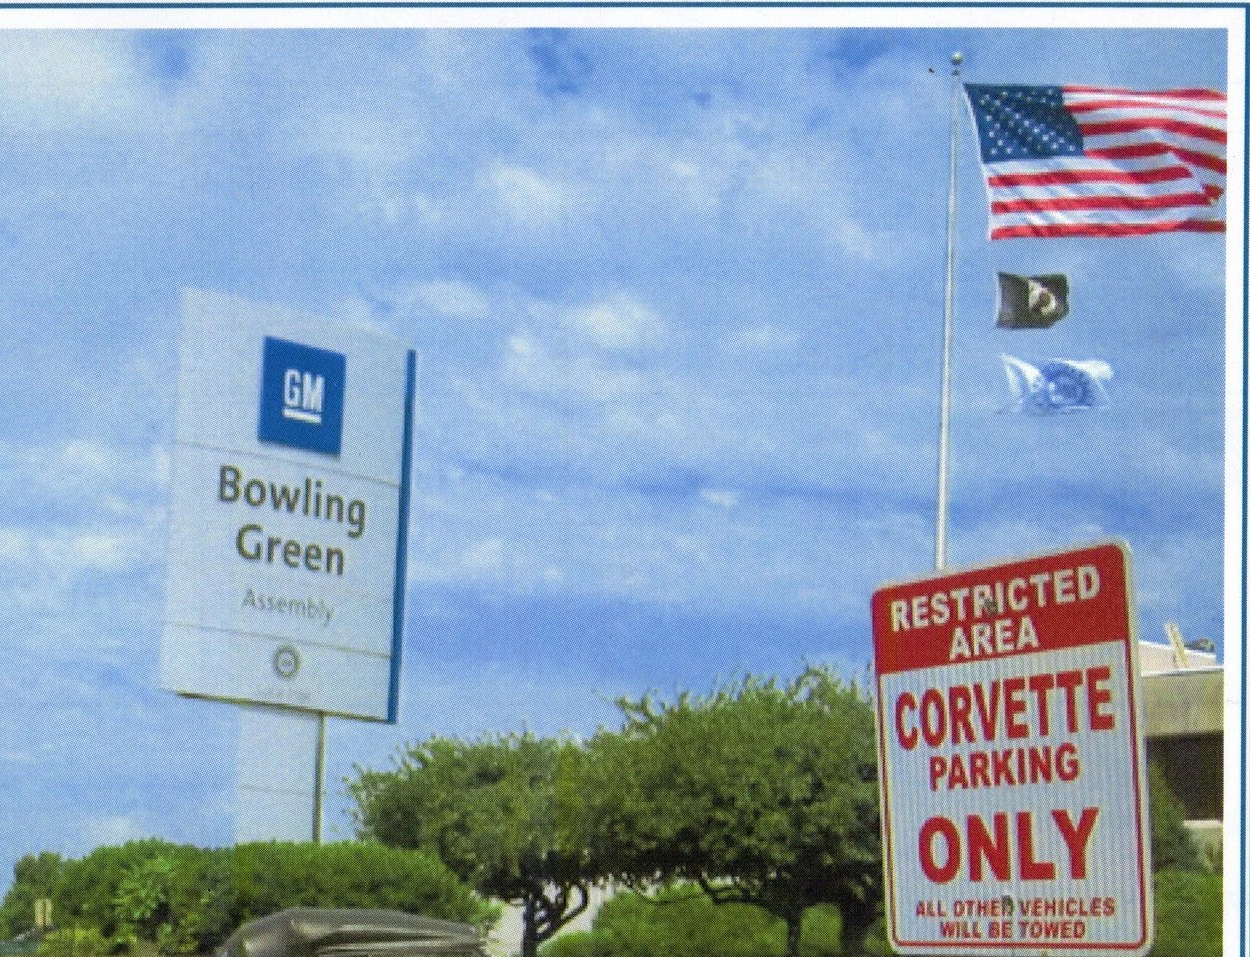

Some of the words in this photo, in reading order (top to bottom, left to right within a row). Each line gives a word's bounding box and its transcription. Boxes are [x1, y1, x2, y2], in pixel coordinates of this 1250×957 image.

[284, 368, 325, 412] GM
[219, 465, 366, 538] Bowling
[236, 524, 344, 576] Green
[241, 589, 334, 627] Assembly
[891, 565, 1100, 632] RESTRICTED
[949, 617, 1040, 662] AREA
[895, 666, 1115, 750] CORVETTE
[929, 742, 1080, 791] PARKING
[918, 806, 1100, 884] ONLY
[916, 900, 947, 917] ALL
[1018, 897, 1116, 917] VEHICLES
[940, 921, 982, 938] WILL
[988, 921, 1013, 938] BE
[1019, 921, 1086, 939] TOWED
